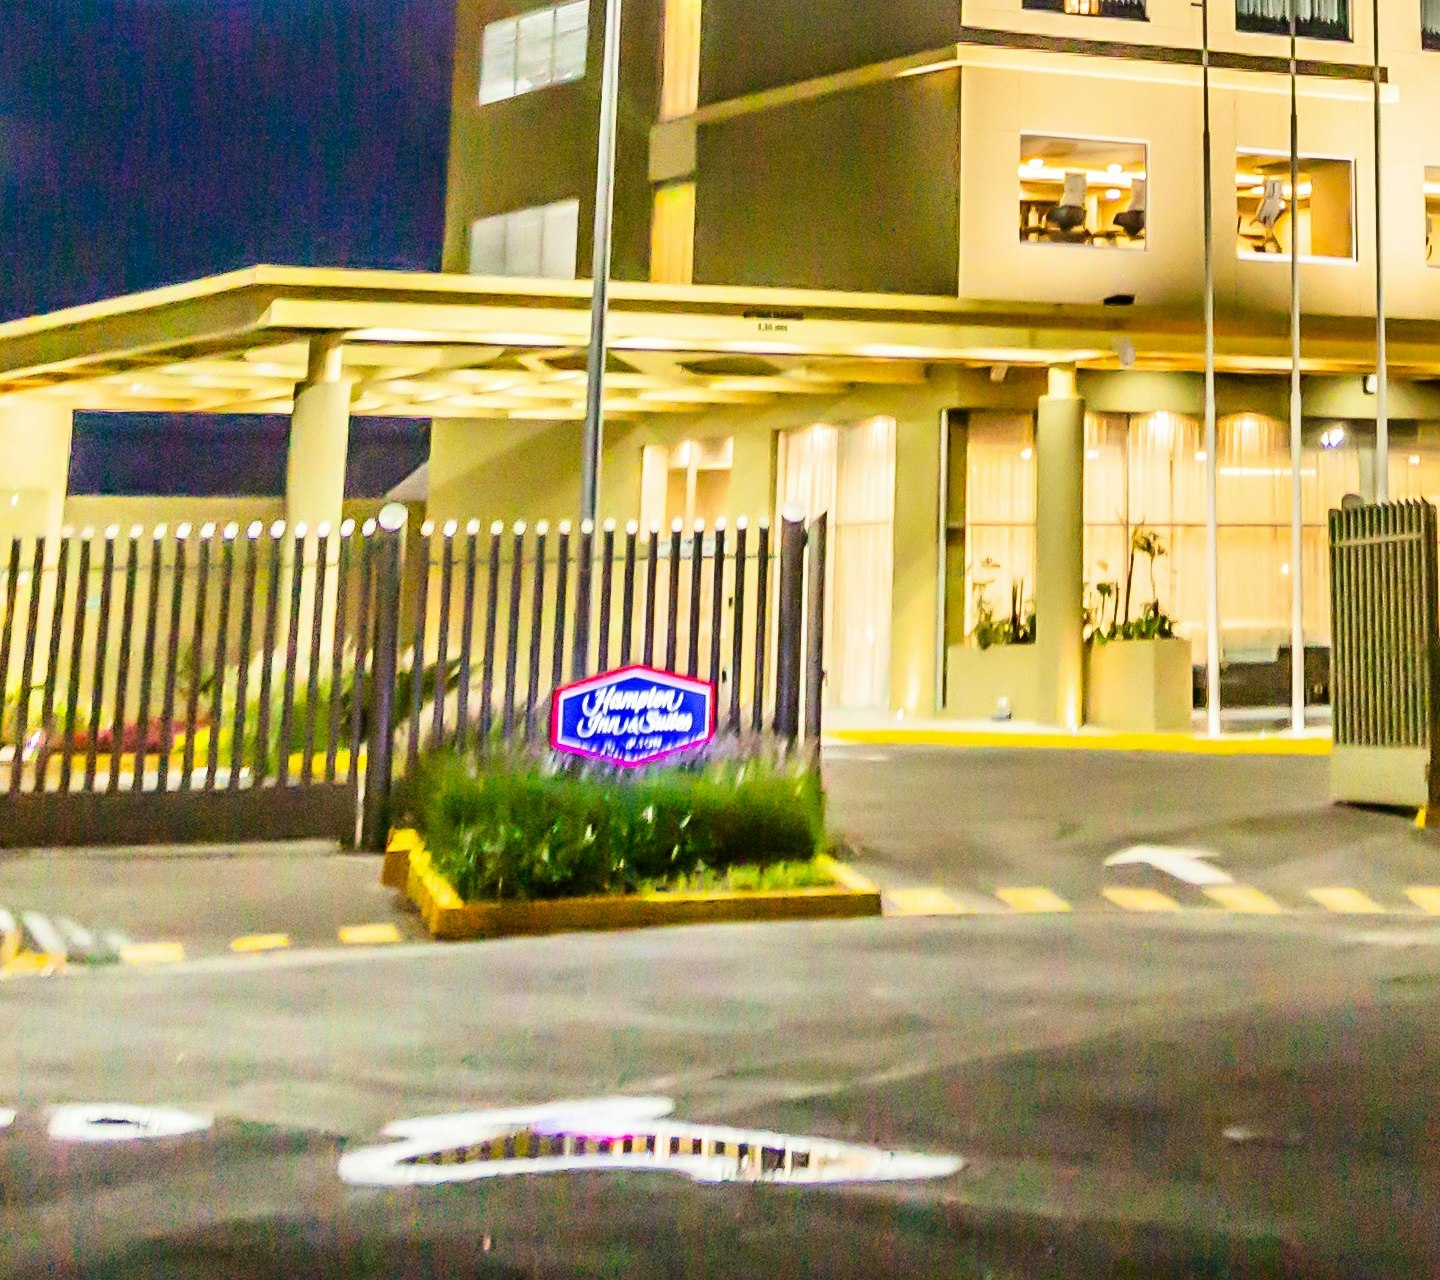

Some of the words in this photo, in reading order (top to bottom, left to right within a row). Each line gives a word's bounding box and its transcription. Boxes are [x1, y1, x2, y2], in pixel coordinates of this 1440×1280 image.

[581, 685, 684, 717] Hampton
[576, 713, 630, 738] Inn
[638, 709, 693, 734] Suites
